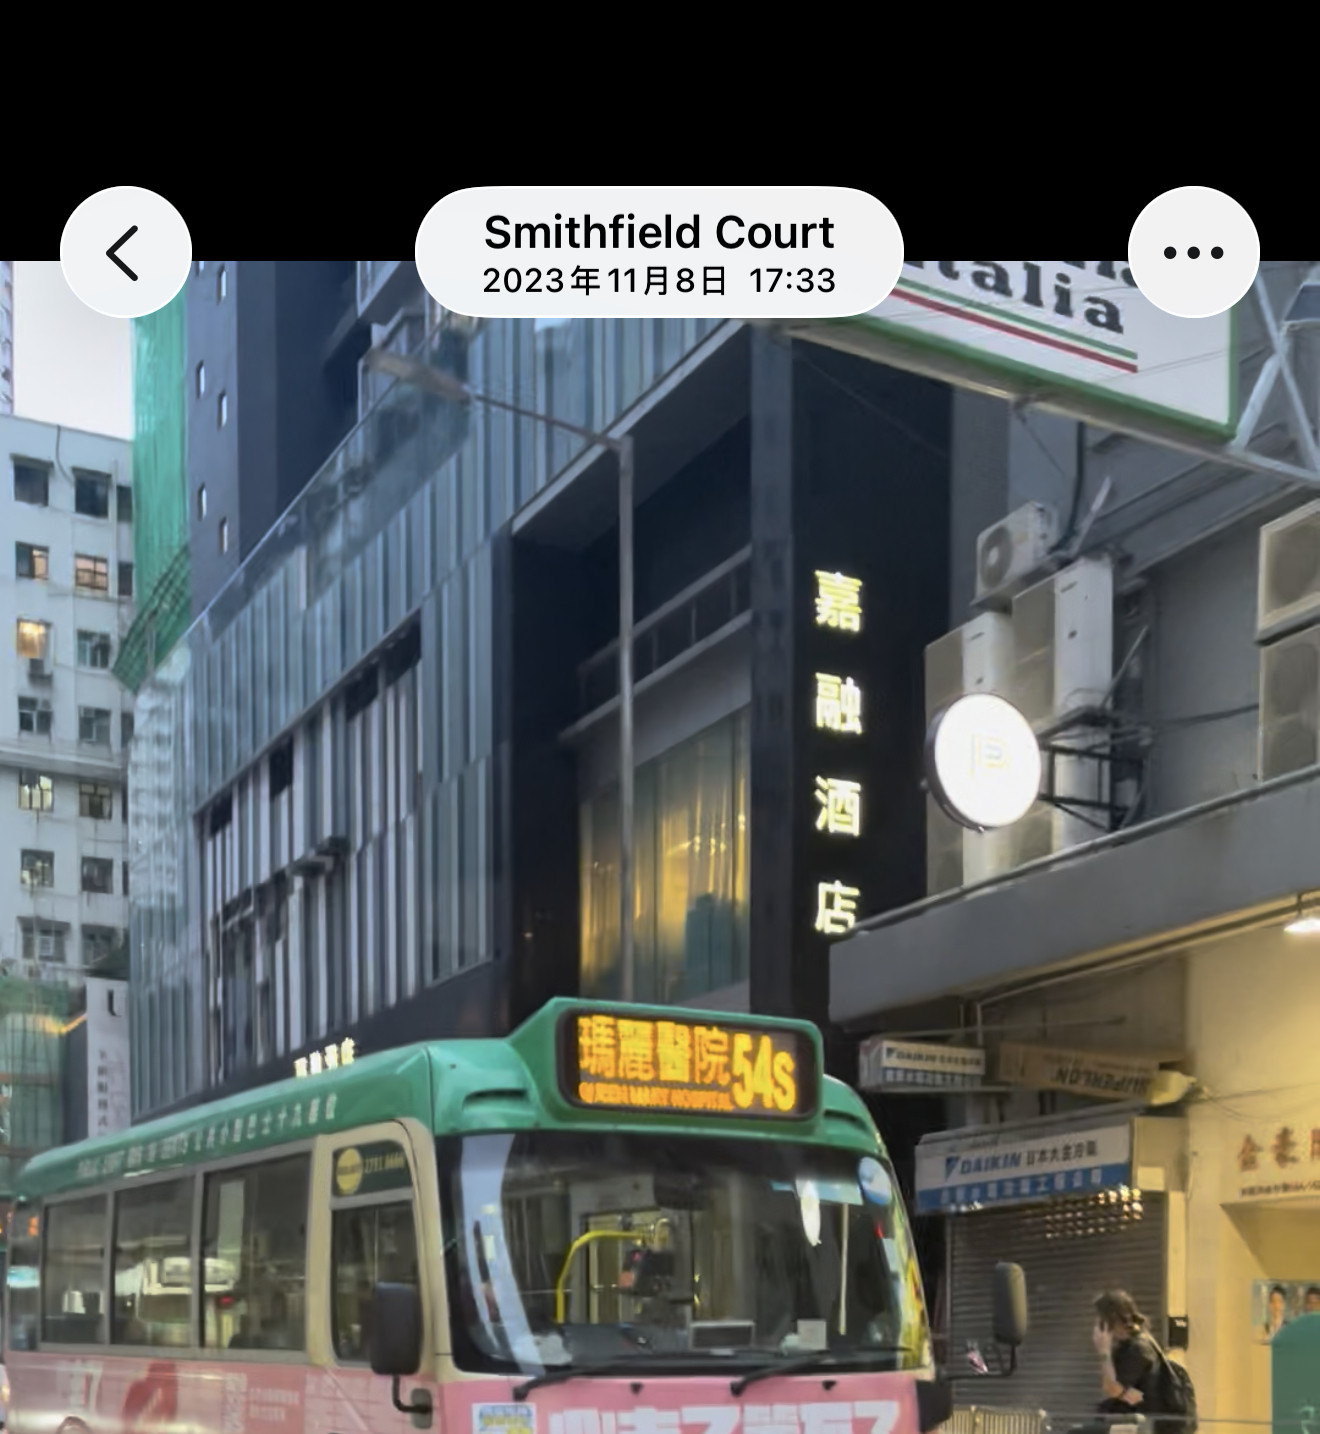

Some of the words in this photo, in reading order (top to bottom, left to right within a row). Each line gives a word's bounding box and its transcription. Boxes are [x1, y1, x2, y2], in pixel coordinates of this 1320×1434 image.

[814, 569, 863, 935] 嘉融酒店
[578, 1015, 731, 1086] 瑪麗醫院
[960, 1151, 1022, 1175] DAIKIN
